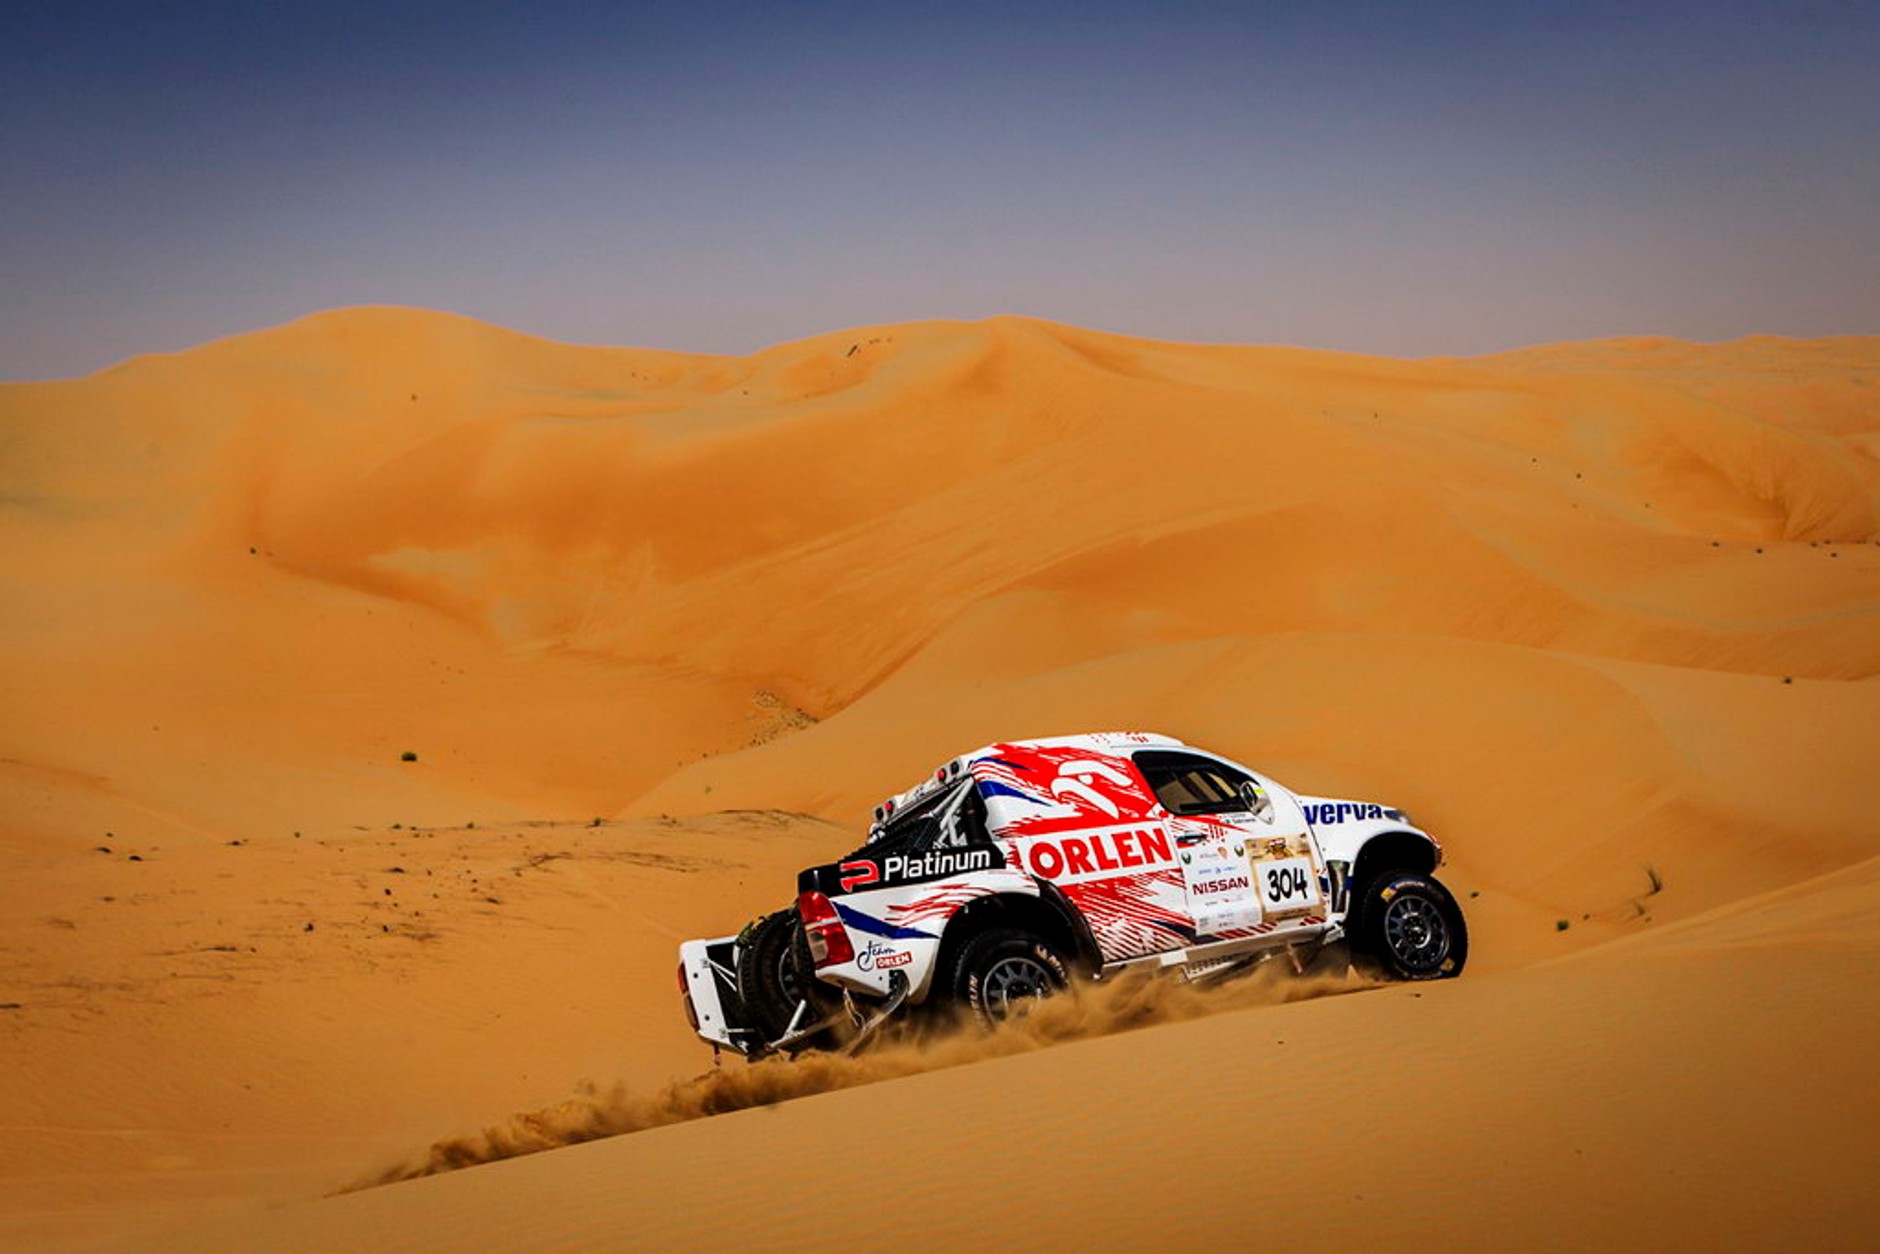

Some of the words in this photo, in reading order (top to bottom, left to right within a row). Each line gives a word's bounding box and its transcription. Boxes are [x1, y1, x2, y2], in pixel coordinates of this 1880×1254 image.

[1303, 803, 1382, 825] verva
[884, 850, 990, 882] Platinum
[1029, 828, 1173, 879] ORLEN
[1192, 876, 1249, 895] NISSAN
[1267, 867, 1308, 902] 304
